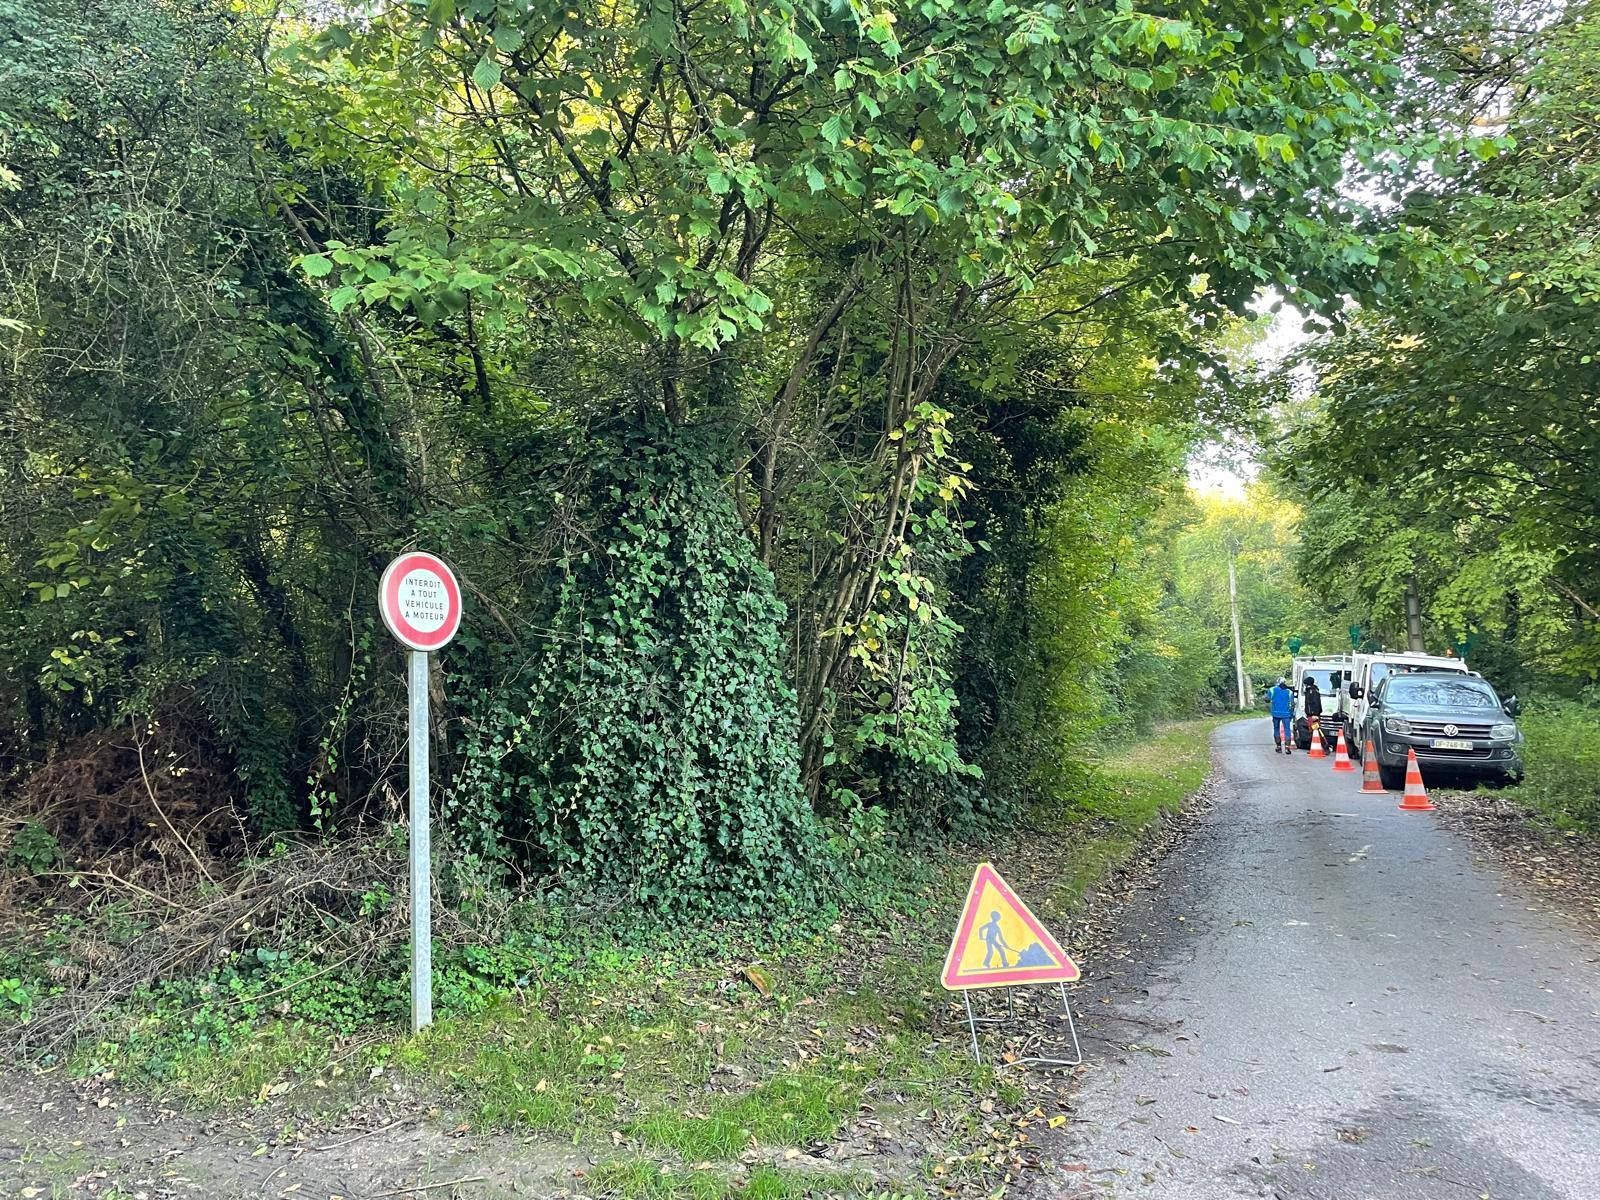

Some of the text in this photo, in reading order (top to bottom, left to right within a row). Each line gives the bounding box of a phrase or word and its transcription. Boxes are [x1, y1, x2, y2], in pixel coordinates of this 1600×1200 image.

[405, 578, 441, 588] INTERDIT
[411, 589, 437, 598] A TOUT
[405, 600, 444, 610] VEHICULE
[405, 611, 444, 621] A MOTEUR
